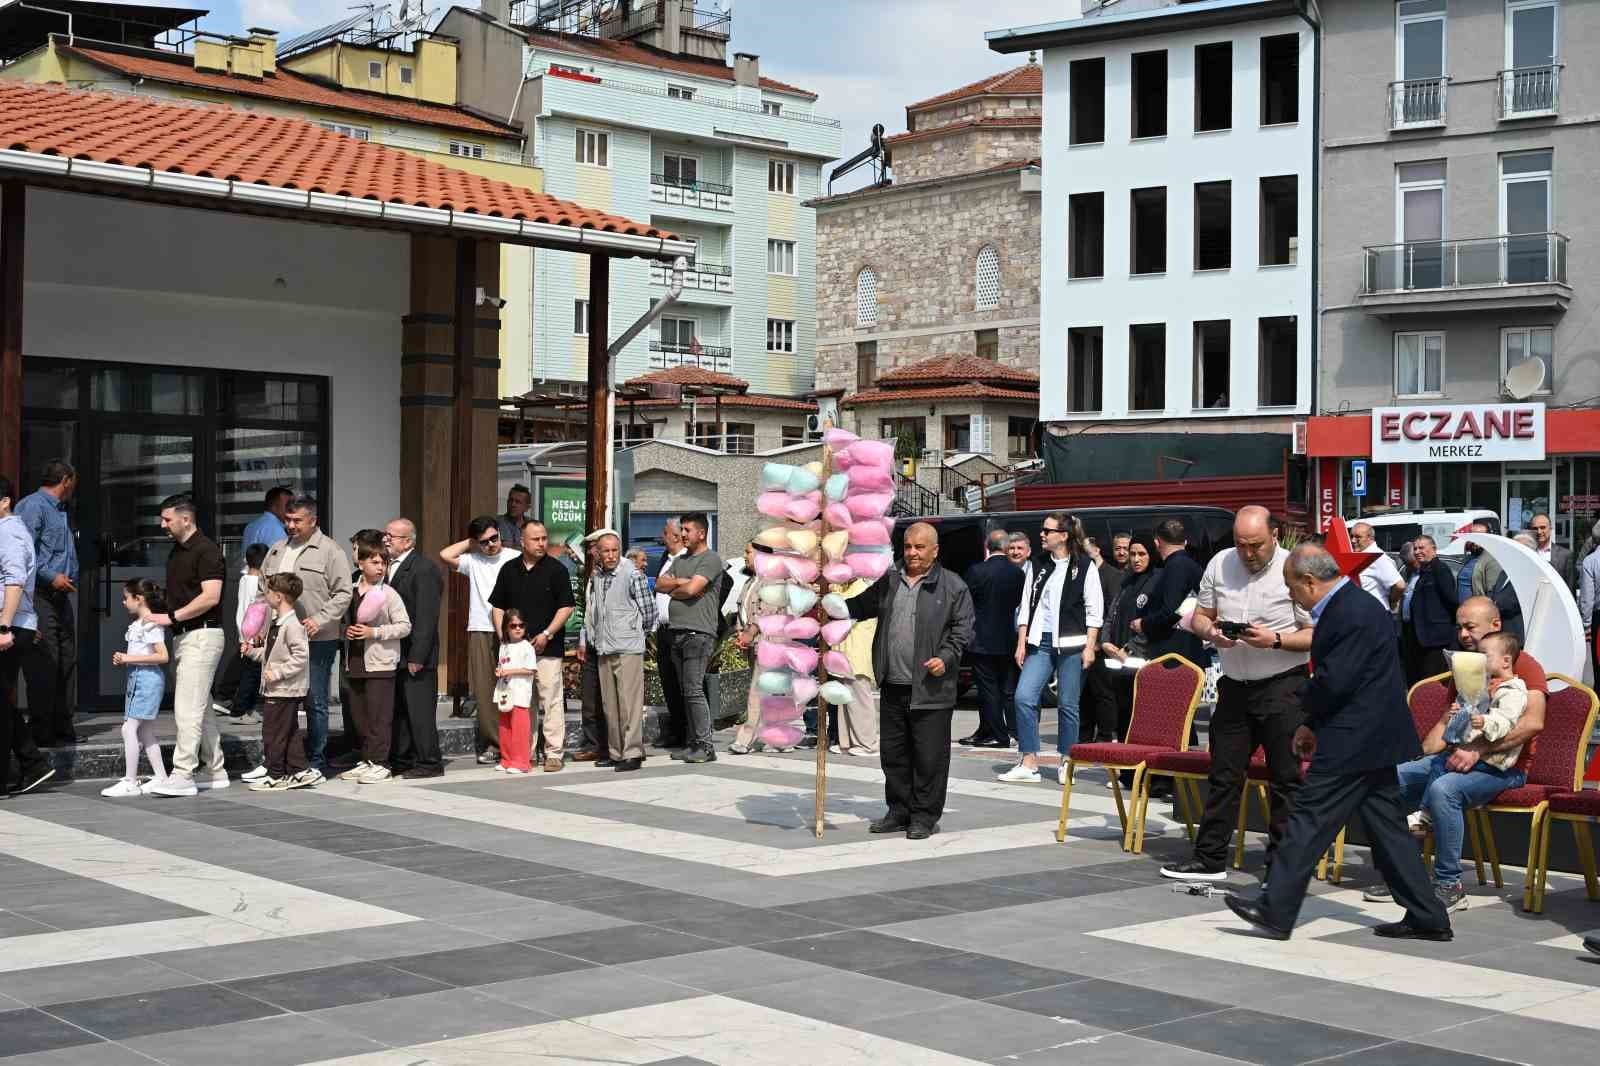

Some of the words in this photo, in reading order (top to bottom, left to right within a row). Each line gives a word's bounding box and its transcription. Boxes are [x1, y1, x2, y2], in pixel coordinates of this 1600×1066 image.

[1381, 409, 1535, 441] ECZANE
[1429, 445, 1483, 457] MERKEZ
[1356, 469, 1363, 487] D
[552, 500, 580, 510] MESAJ
[1322, 488, 1333, 532] ECZ
[552, 510, 582, 523] ÇÖZÜM
